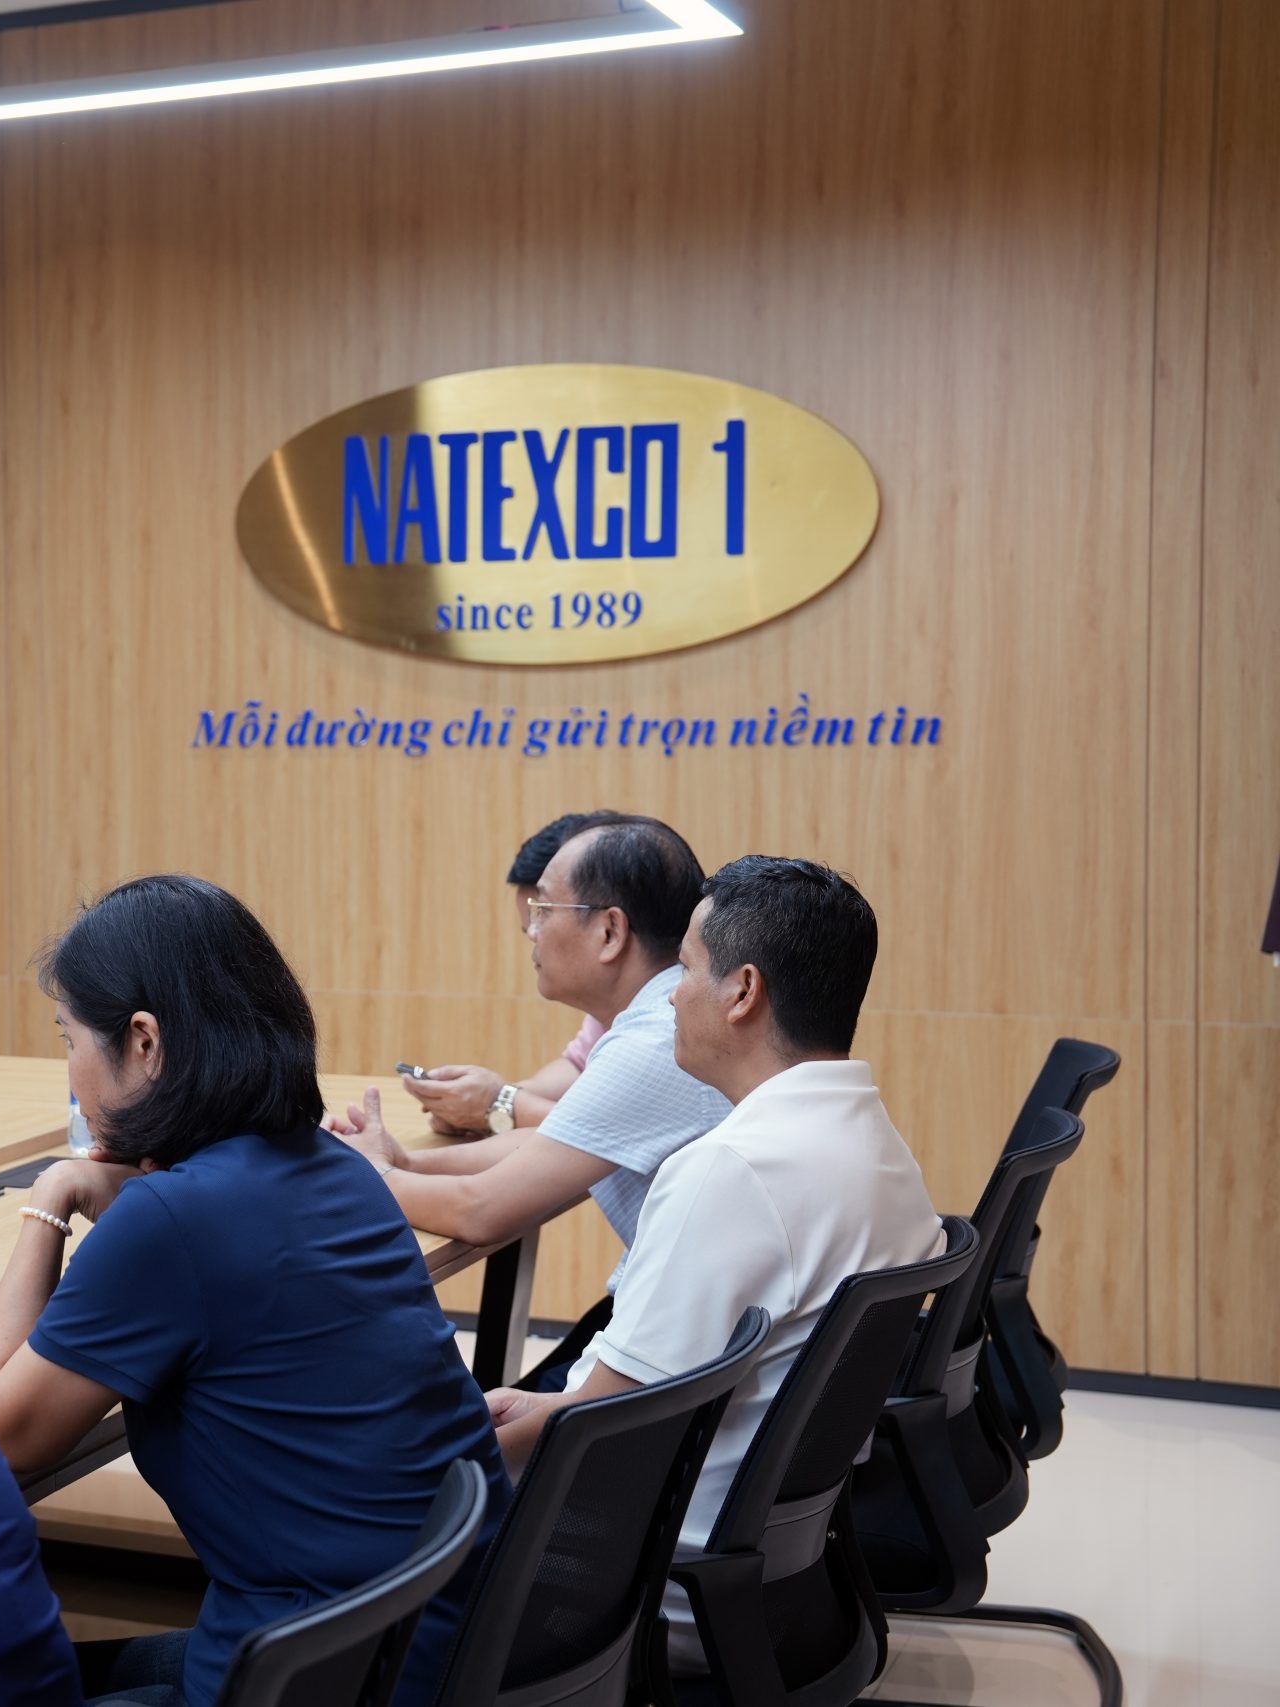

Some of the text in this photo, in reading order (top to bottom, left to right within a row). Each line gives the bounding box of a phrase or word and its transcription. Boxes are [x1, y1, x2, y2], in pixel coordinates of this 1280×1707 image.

[343, 419, 745, 566] NATEXCO 1
[436, 591, 643, 632] since 1989
[193, 692, 943, 758] Mỗi đường chỉ gửi trọn niềm tin
